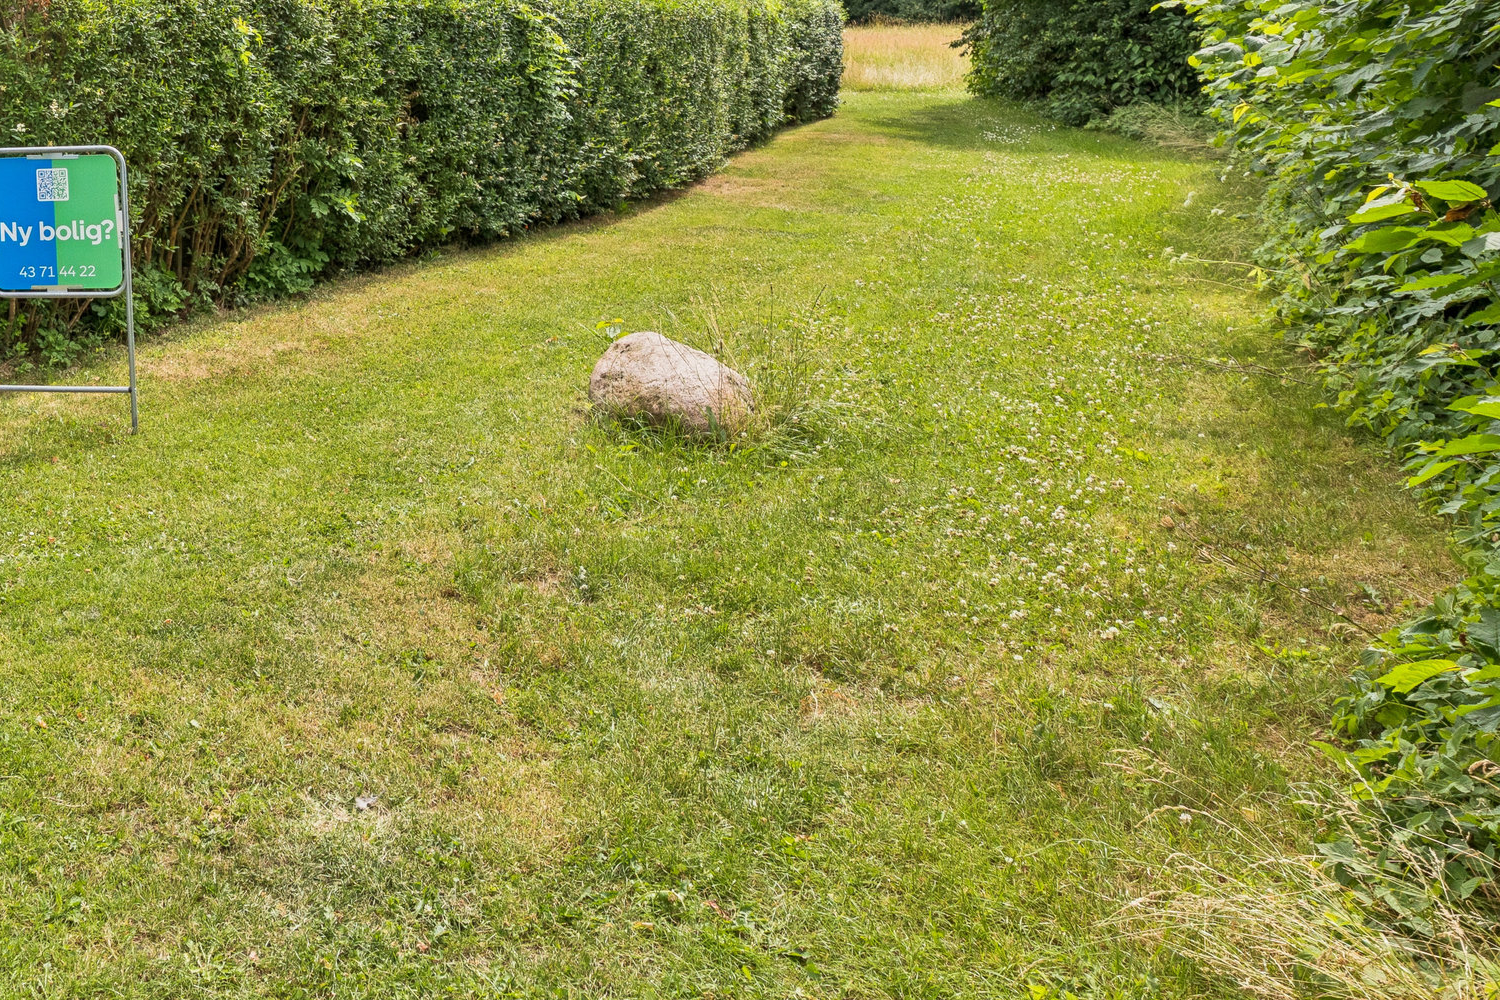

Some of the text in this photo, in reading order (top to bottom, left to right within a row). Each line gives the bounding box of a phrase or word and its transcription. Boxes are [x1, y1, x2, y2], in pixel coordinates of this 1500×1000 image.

[0, 219, 114, 247] Ny bolig?
[19, 265, 96, 278] 43 71 44 22
